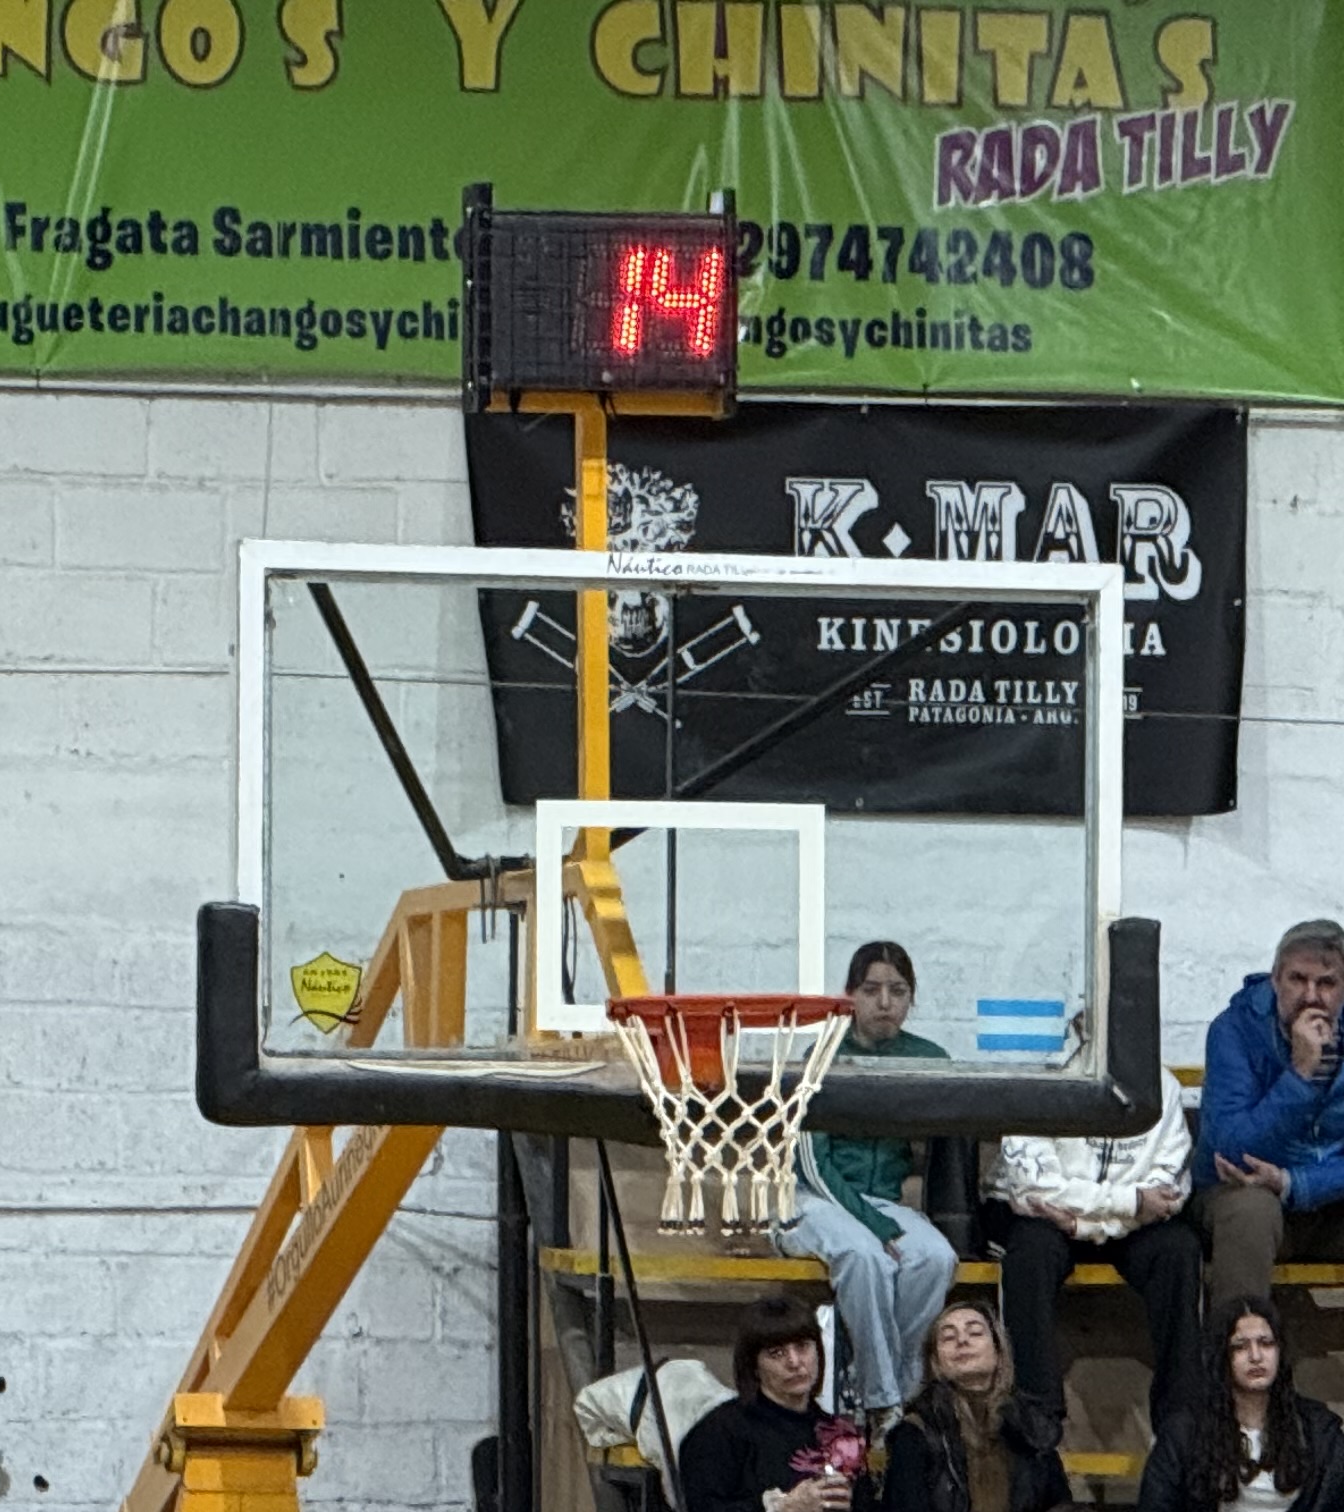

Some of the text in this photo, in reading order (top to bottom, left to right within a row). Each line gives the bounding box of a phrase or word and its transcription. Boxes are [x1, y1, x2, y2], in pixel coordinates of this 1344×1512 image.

[434, 0, 523, 92] Y
[933, 97, 1296, 211] RADA TILLY
[5, 201, 199, 272] Fragata
[737, 221, 1094, 290] 2974742408
[615, 247, 723, 357] 14
[908, 677, 1079, 706] RADA TILLY
[908, 708, 1016, 725] PATAGONIA
